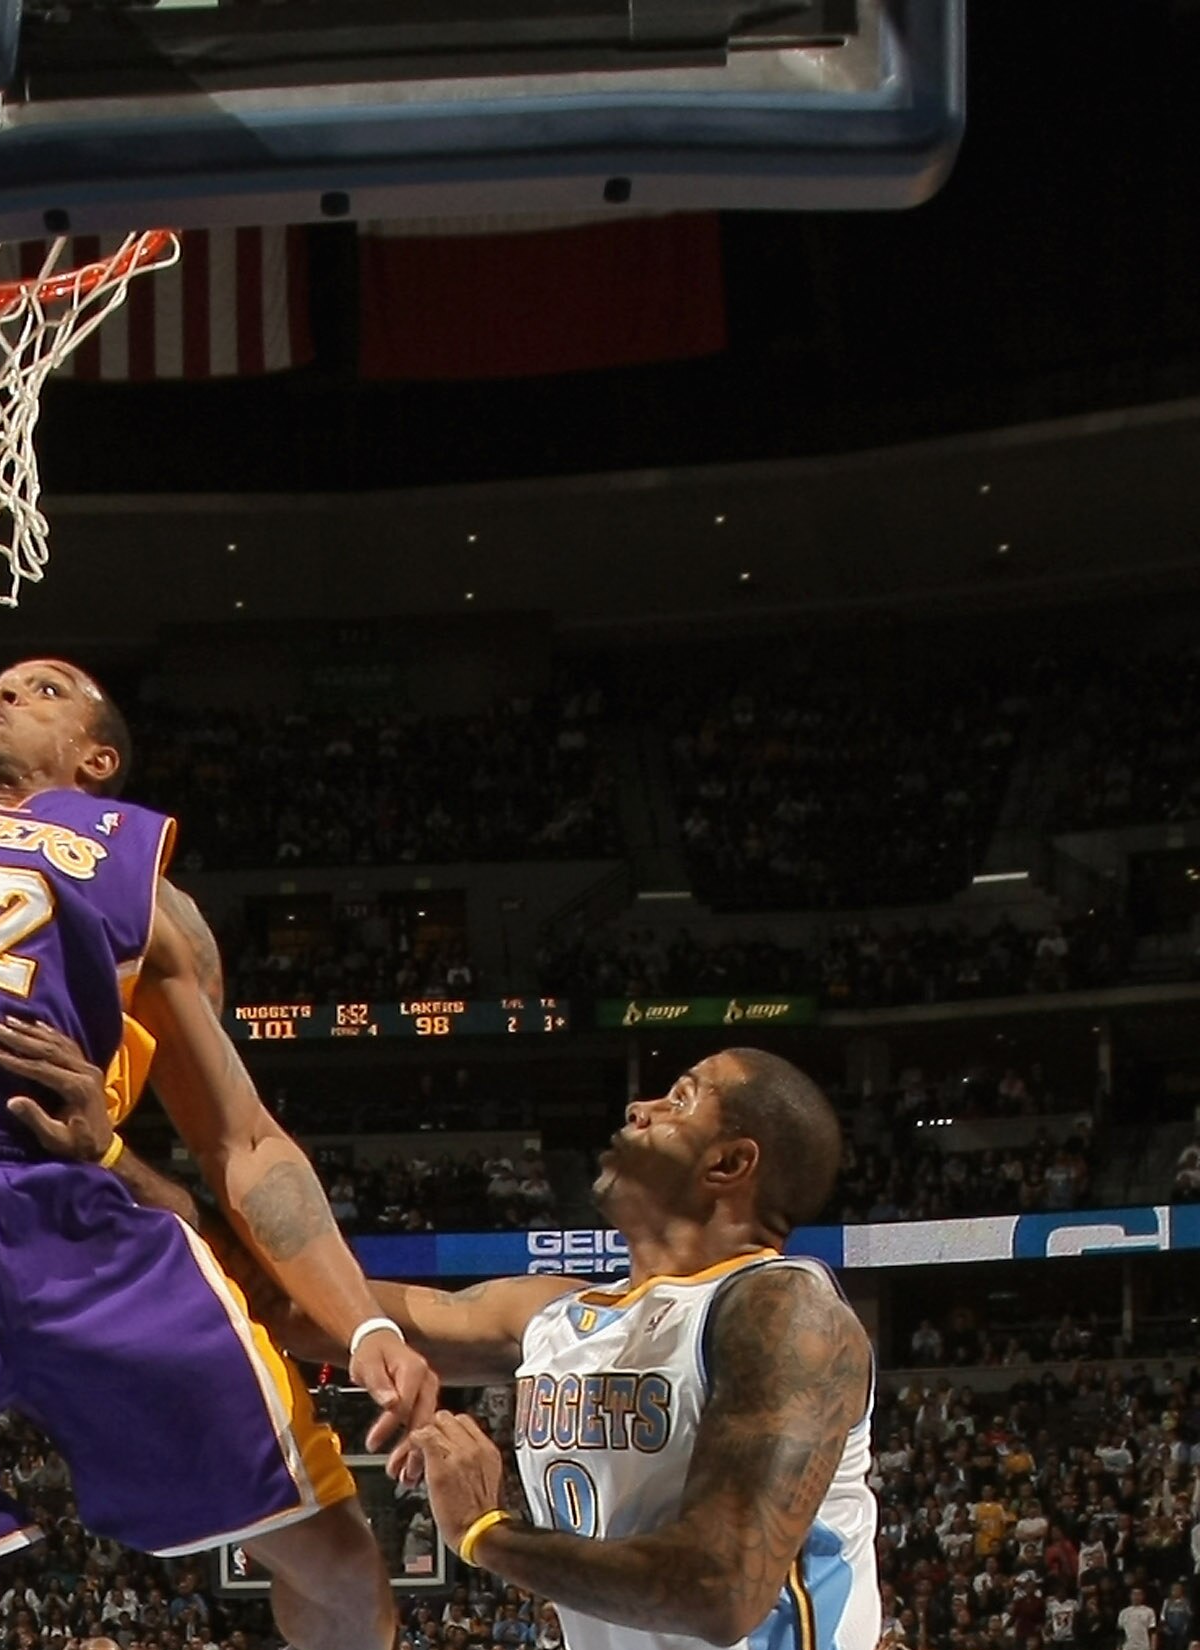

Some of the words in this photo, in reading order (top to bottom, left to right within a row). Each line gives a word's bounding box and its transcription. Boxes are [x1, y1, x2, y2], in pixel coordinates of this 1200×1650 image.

[235, 1005, 311, 1020] NUGGETS
[400, 1001, 464, 1015] LAKERS
[247, 1021, 297, 1039] 101
[367, 1024, 378, 1036] 4
[416, 1016, 450, 1035] 98
[507, 1016, 517, 1033] 2
[545, 1460, 598, 1540] 0
